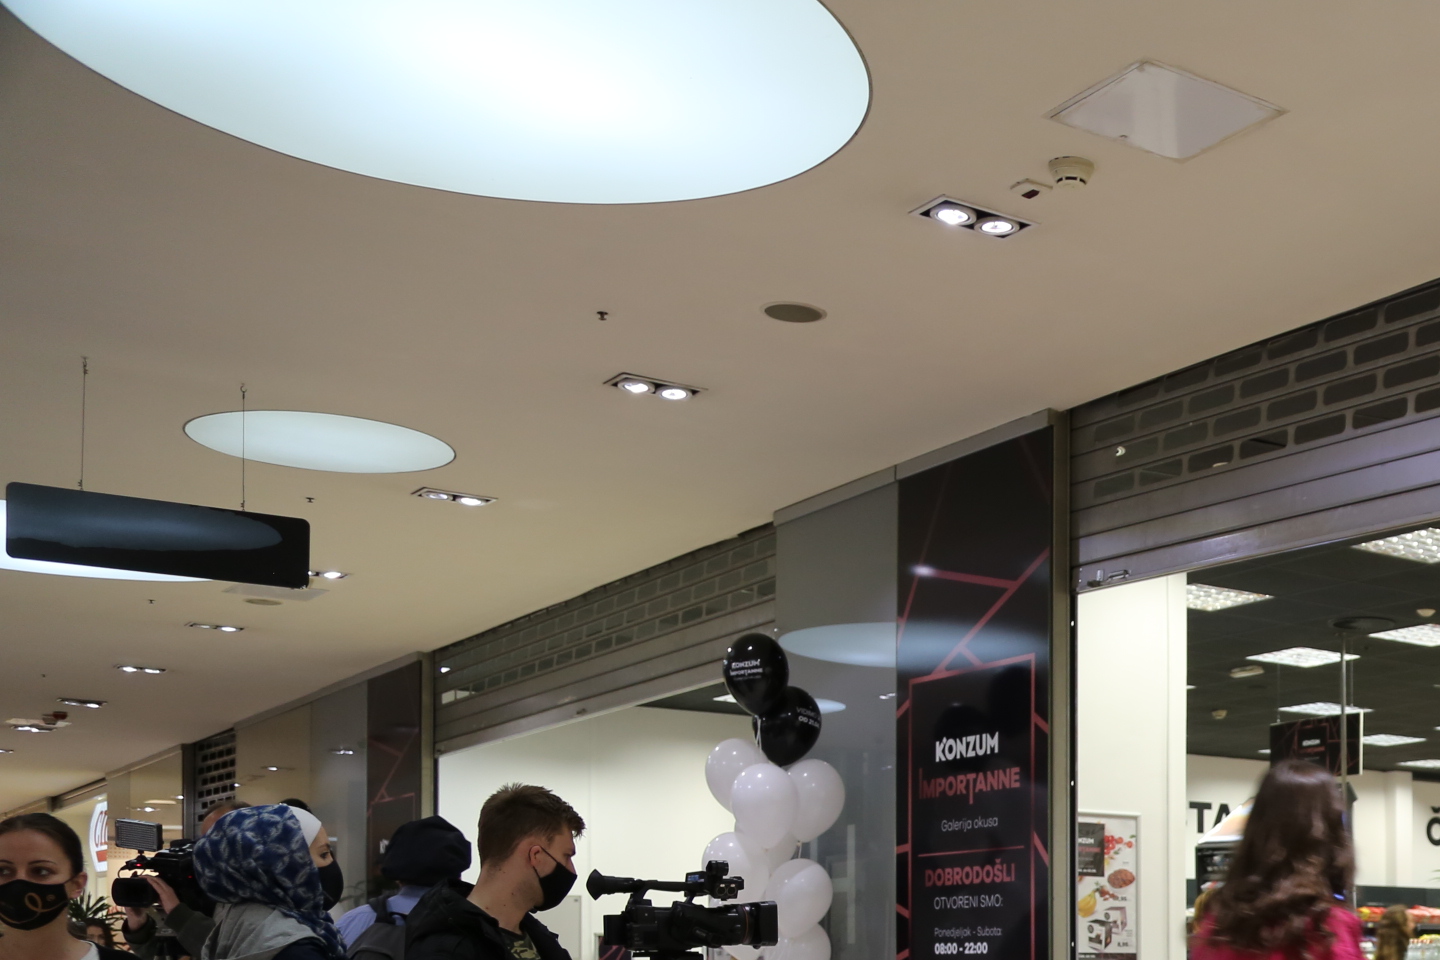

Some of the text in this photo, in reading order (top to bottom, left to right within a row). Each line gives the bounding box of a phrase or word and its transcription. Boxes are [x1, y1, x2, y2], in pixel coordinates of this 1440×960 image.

[935, 731, 999, 762] KONZUM
[919, 767, 1020, 805] IMPORTANNE
[941, 816, 998, 832] Galerija okusa
[925, 858, 1015, 887] DOBRODOŠLI
[934, 894, 1003, 910] OTVORENI SMO:
[934, 927, 971, 938] Ponedjeljak
[934, 943, 958, 955] 08:00
[964, 942, 988, 954] 22:00
